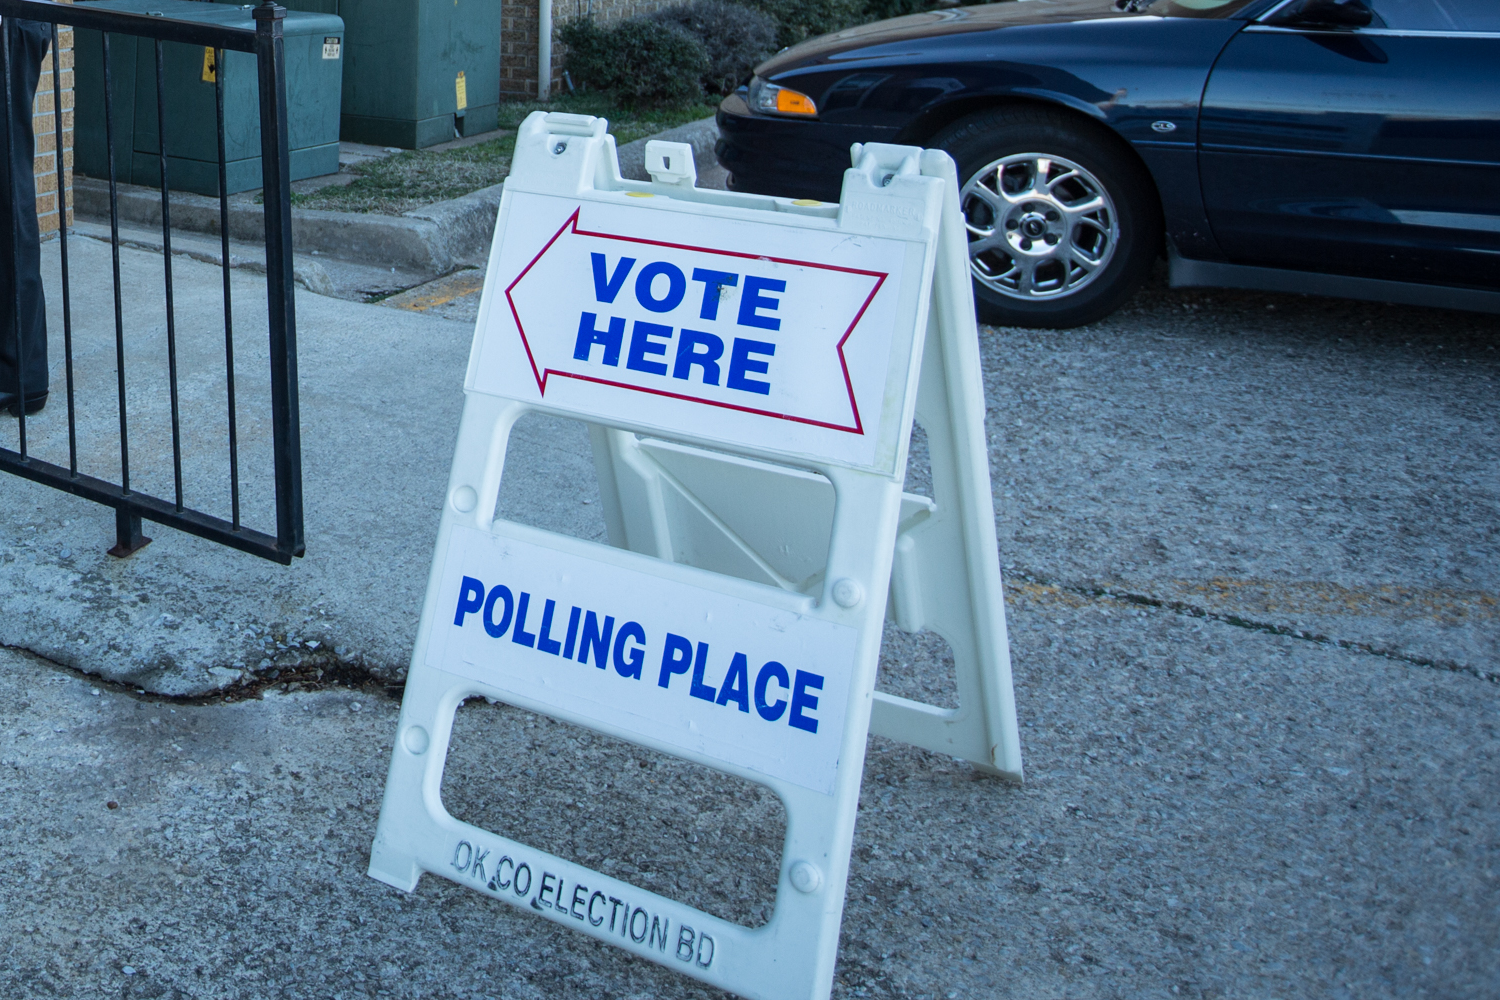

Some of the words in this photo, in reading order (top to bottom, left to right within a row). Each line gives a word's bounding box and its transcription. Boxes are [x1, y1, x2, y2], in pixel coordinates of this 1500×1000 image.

[852, 201, 915, 215] ROADMARKER
[590, 251, 787, 331] VOTE
[573, 311, 776, 396] HERE
[453, 575, 647, 681] POLLING
[657, 632, 825, 735] PLACE
[454, 840, 491, 883] OK
[538, 871, 670, 953] ELECTION
[676, 924, 716, 970] BD
